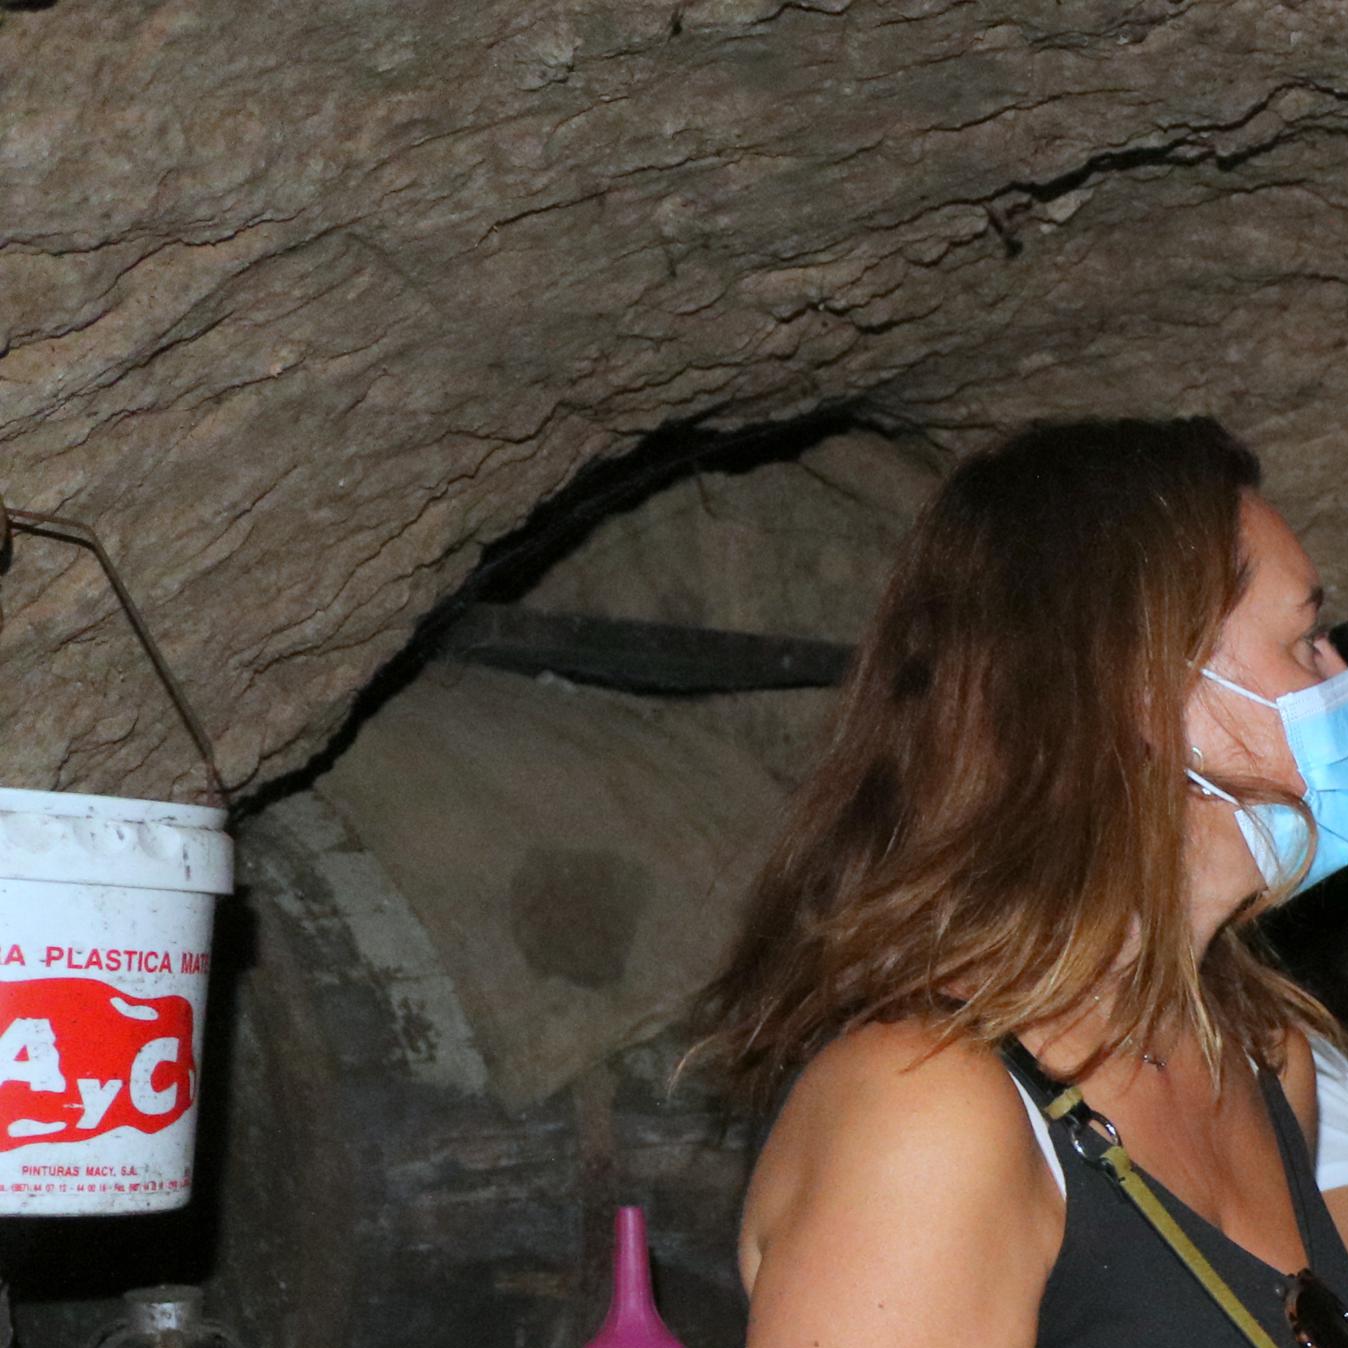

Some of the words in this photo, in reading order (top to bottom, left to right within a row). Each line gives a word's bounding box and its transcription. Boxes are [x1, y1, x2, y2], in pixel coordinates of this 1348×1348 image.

[0, 944, 25, 967] A
[45, 946, 172, 973] PLASTICA
[22, 1165, 79, 1177] PINTURAS
